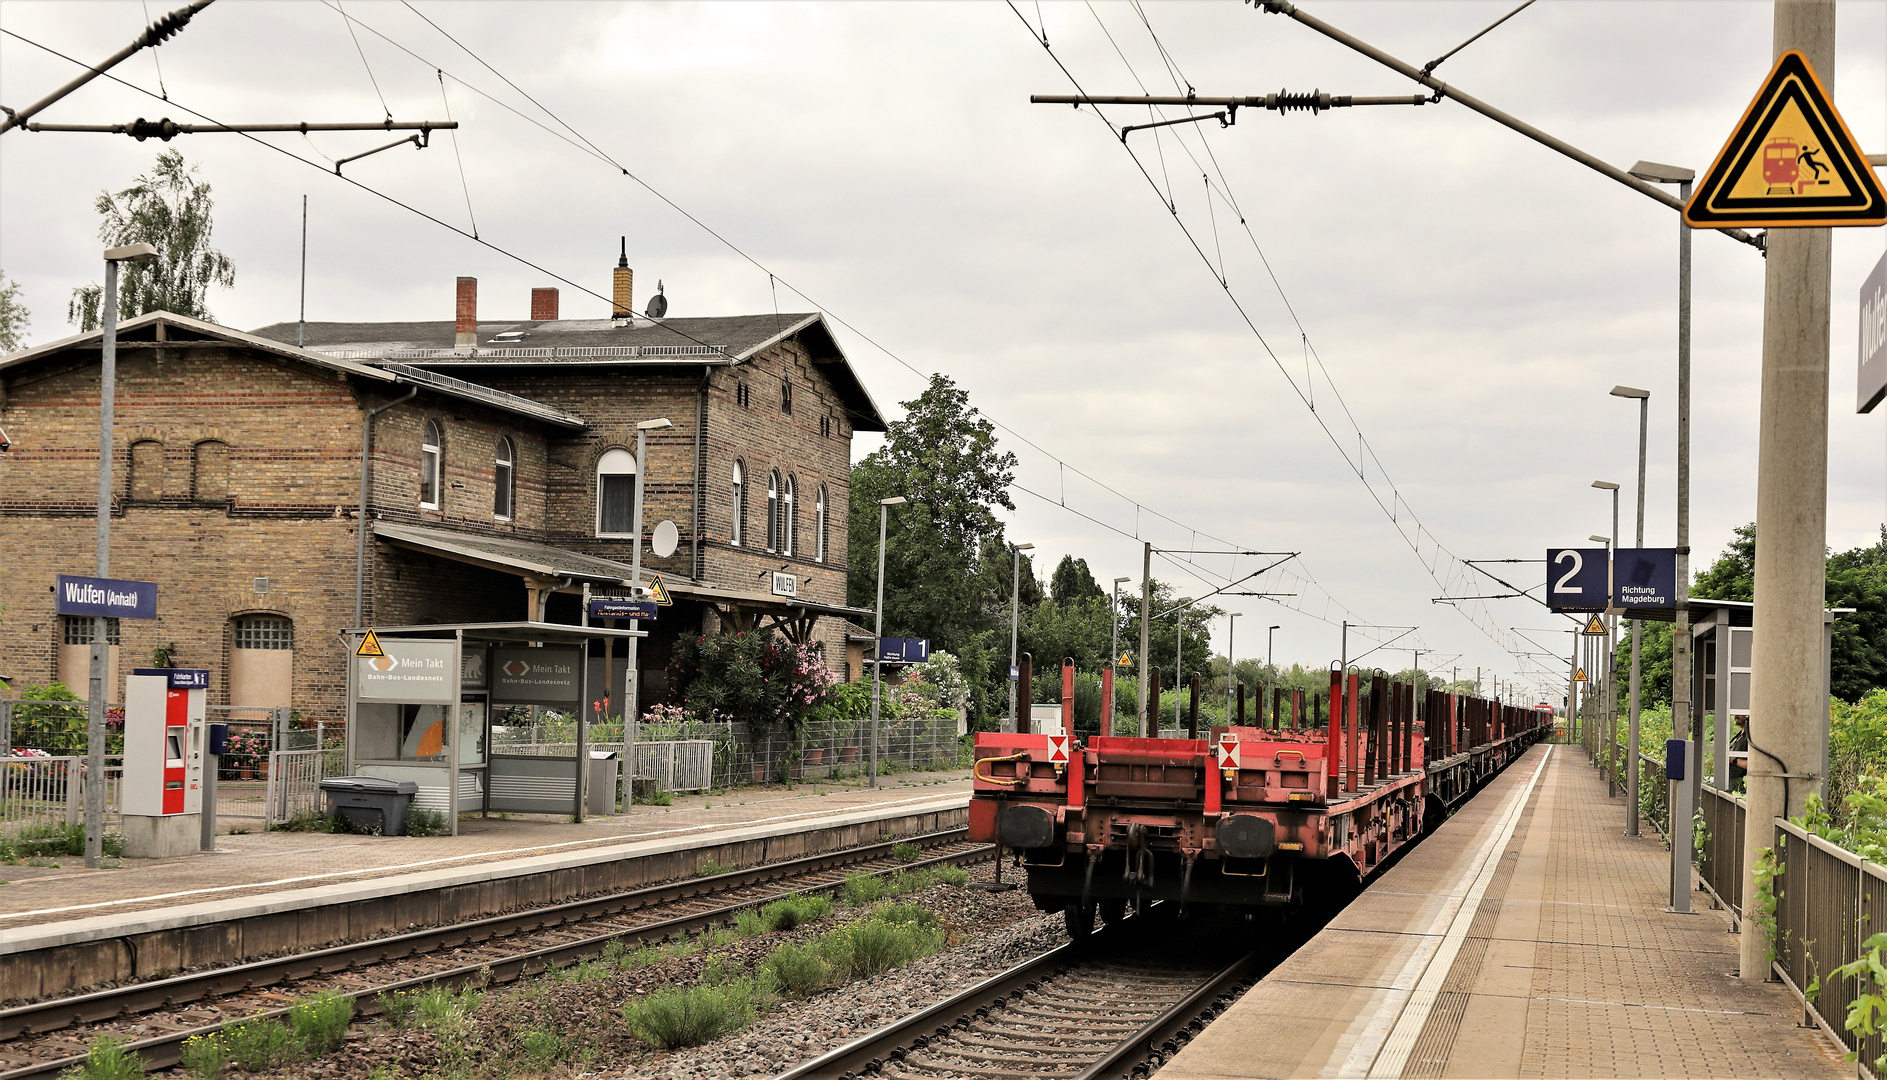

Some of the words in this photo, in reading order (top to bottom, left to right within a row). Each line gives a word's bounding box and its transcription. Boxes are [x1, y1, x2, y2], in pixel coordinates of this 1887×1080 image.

[1553, 549, 1583, 594] 2
[775, 575, 795, 593] WULFEN
[65, 582, 105, 605] Wulfen
[107, 589, 138, 609] (Anhalt)
[1622, 586, 1656, 595] Richtung
[1622, 595, 1665, 604] Magdeburg
[918, 639, 926, 658] 1
[401, 658, 423, 668] Mein
[425, 658, 444, 669] Takt
[532, 664, 552, 673] Mein
[554, 664, 571, 674] Takt
[367, 673, 444, 682] Bahn-Bus-Landesnetz
[502, 677, 571, 686] Bahn-Bus-Landesnetz
